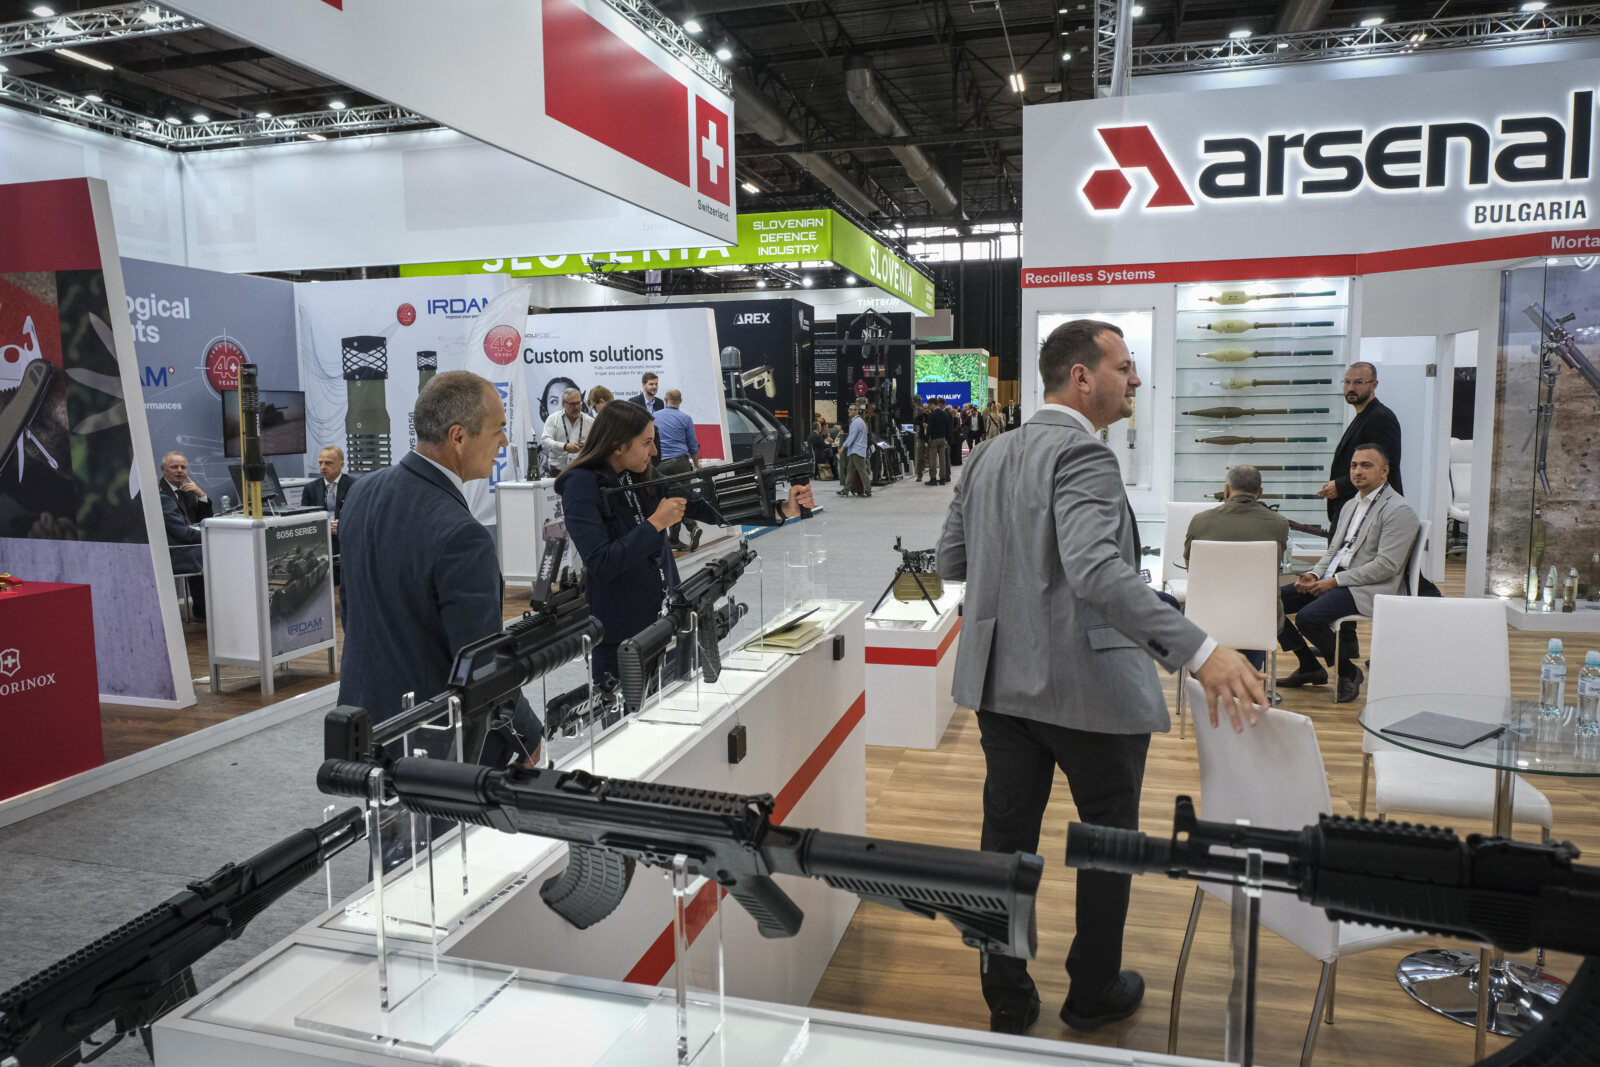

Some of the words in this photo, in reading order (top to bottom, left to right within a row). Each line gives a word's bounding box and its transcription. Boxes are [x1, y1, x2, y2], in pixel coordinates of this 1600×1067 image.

[1198, 91, 1592, 200] arsenal
[1474, 200, 1587, 224] BULGARIA
[752, 217, 824, 231] SLOVENIAN
[759, 231, 817, 244] DEFENCE
[758, 244, 820, 256] INDUSTRY
[870, 245, 913, 298] SLOVENIA
[1025, 272, 1093, 284] Recoilless
[1097, 269, 1155, 283] Systems
[733, 312, 771, 325] AREX
[489, 336, 515, 353] 40
[523, 347, 584, 364] Custom
[590, 345, 664, 362] solutions
[213, 355, 240, 380] 40
[276, 529, 294, 540] 6056
[295, 526, 318, 537] SERIES
[288, 618, 323, 636] IRDAM
[0, 672, 56, 696] ORINOX
